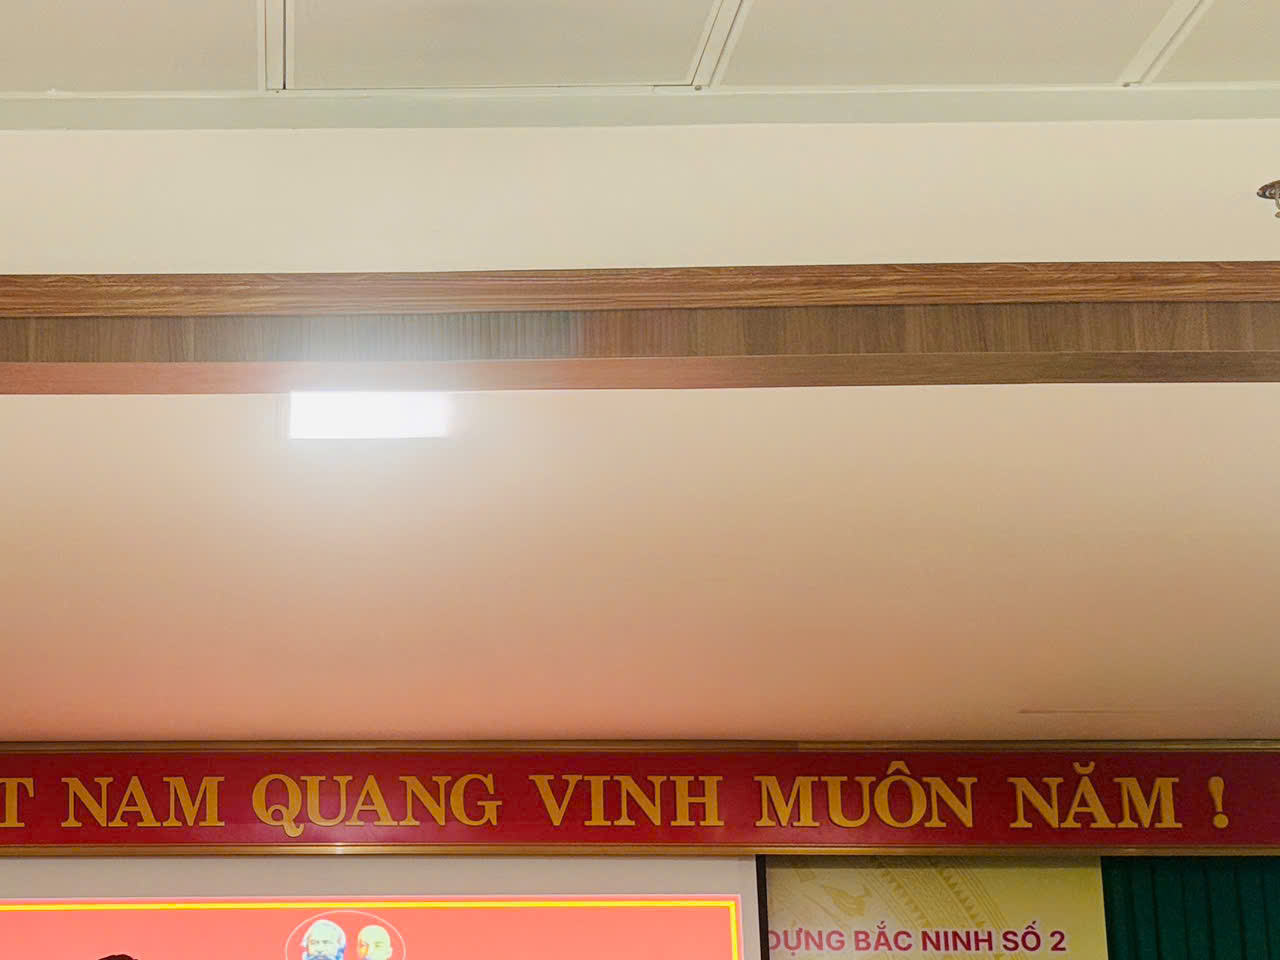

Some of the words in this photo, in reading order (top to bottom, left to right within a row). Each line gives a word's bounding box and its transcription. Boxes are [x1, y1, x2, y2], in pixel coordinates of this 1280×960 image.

[60, 776, 226, 828] NAM
[251, 773, 503, 838] QUANG
[528, 774, 724, 827] VINH
[753, 761, 978, 828] MUÔN
[1008, 761, 1183, 829] NĂM
[854, 921, 913, 952] BẮC
[921, 929, 994, 952] NINH
[1001, 920, 1043, 952] SỐ
[1049, 929, 1067, 952] 2
